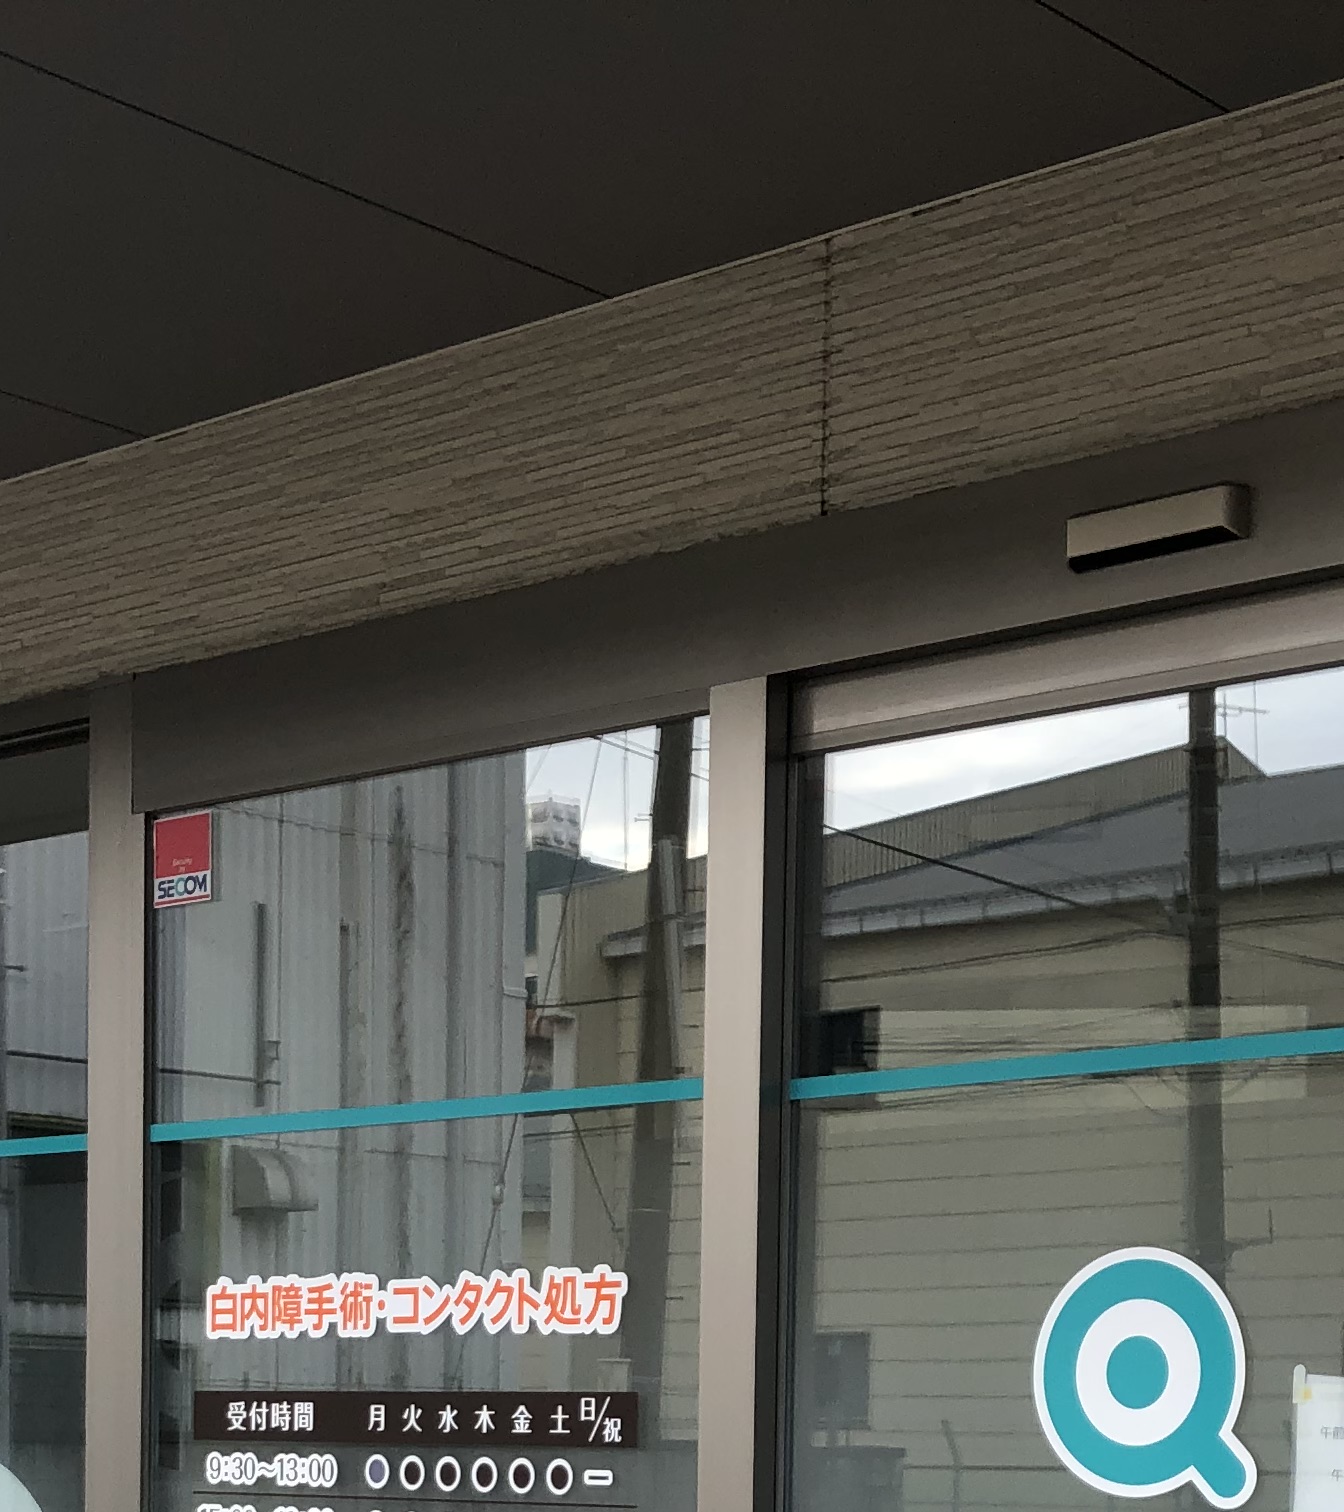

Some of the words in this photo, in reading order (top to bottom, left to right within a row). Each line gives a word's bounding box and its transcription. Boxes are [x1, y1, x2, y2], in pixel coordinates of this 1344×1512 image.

[158, 874, 207, 899] SECOM
[210, 1273, 623, 1332] 白内障手術・コンタクト処方
[227, 1402, 314, 1431] 受付時間
[367, 1404, 387, 1432] 月
[401, 1405, 424, 1432] 火
[437, 1405, 459, 1433] 水
[473, 1405, 496, 1434] 木
[511, 1406, 533, 1435] 金
[549, 1406, 571, 1435] 土
